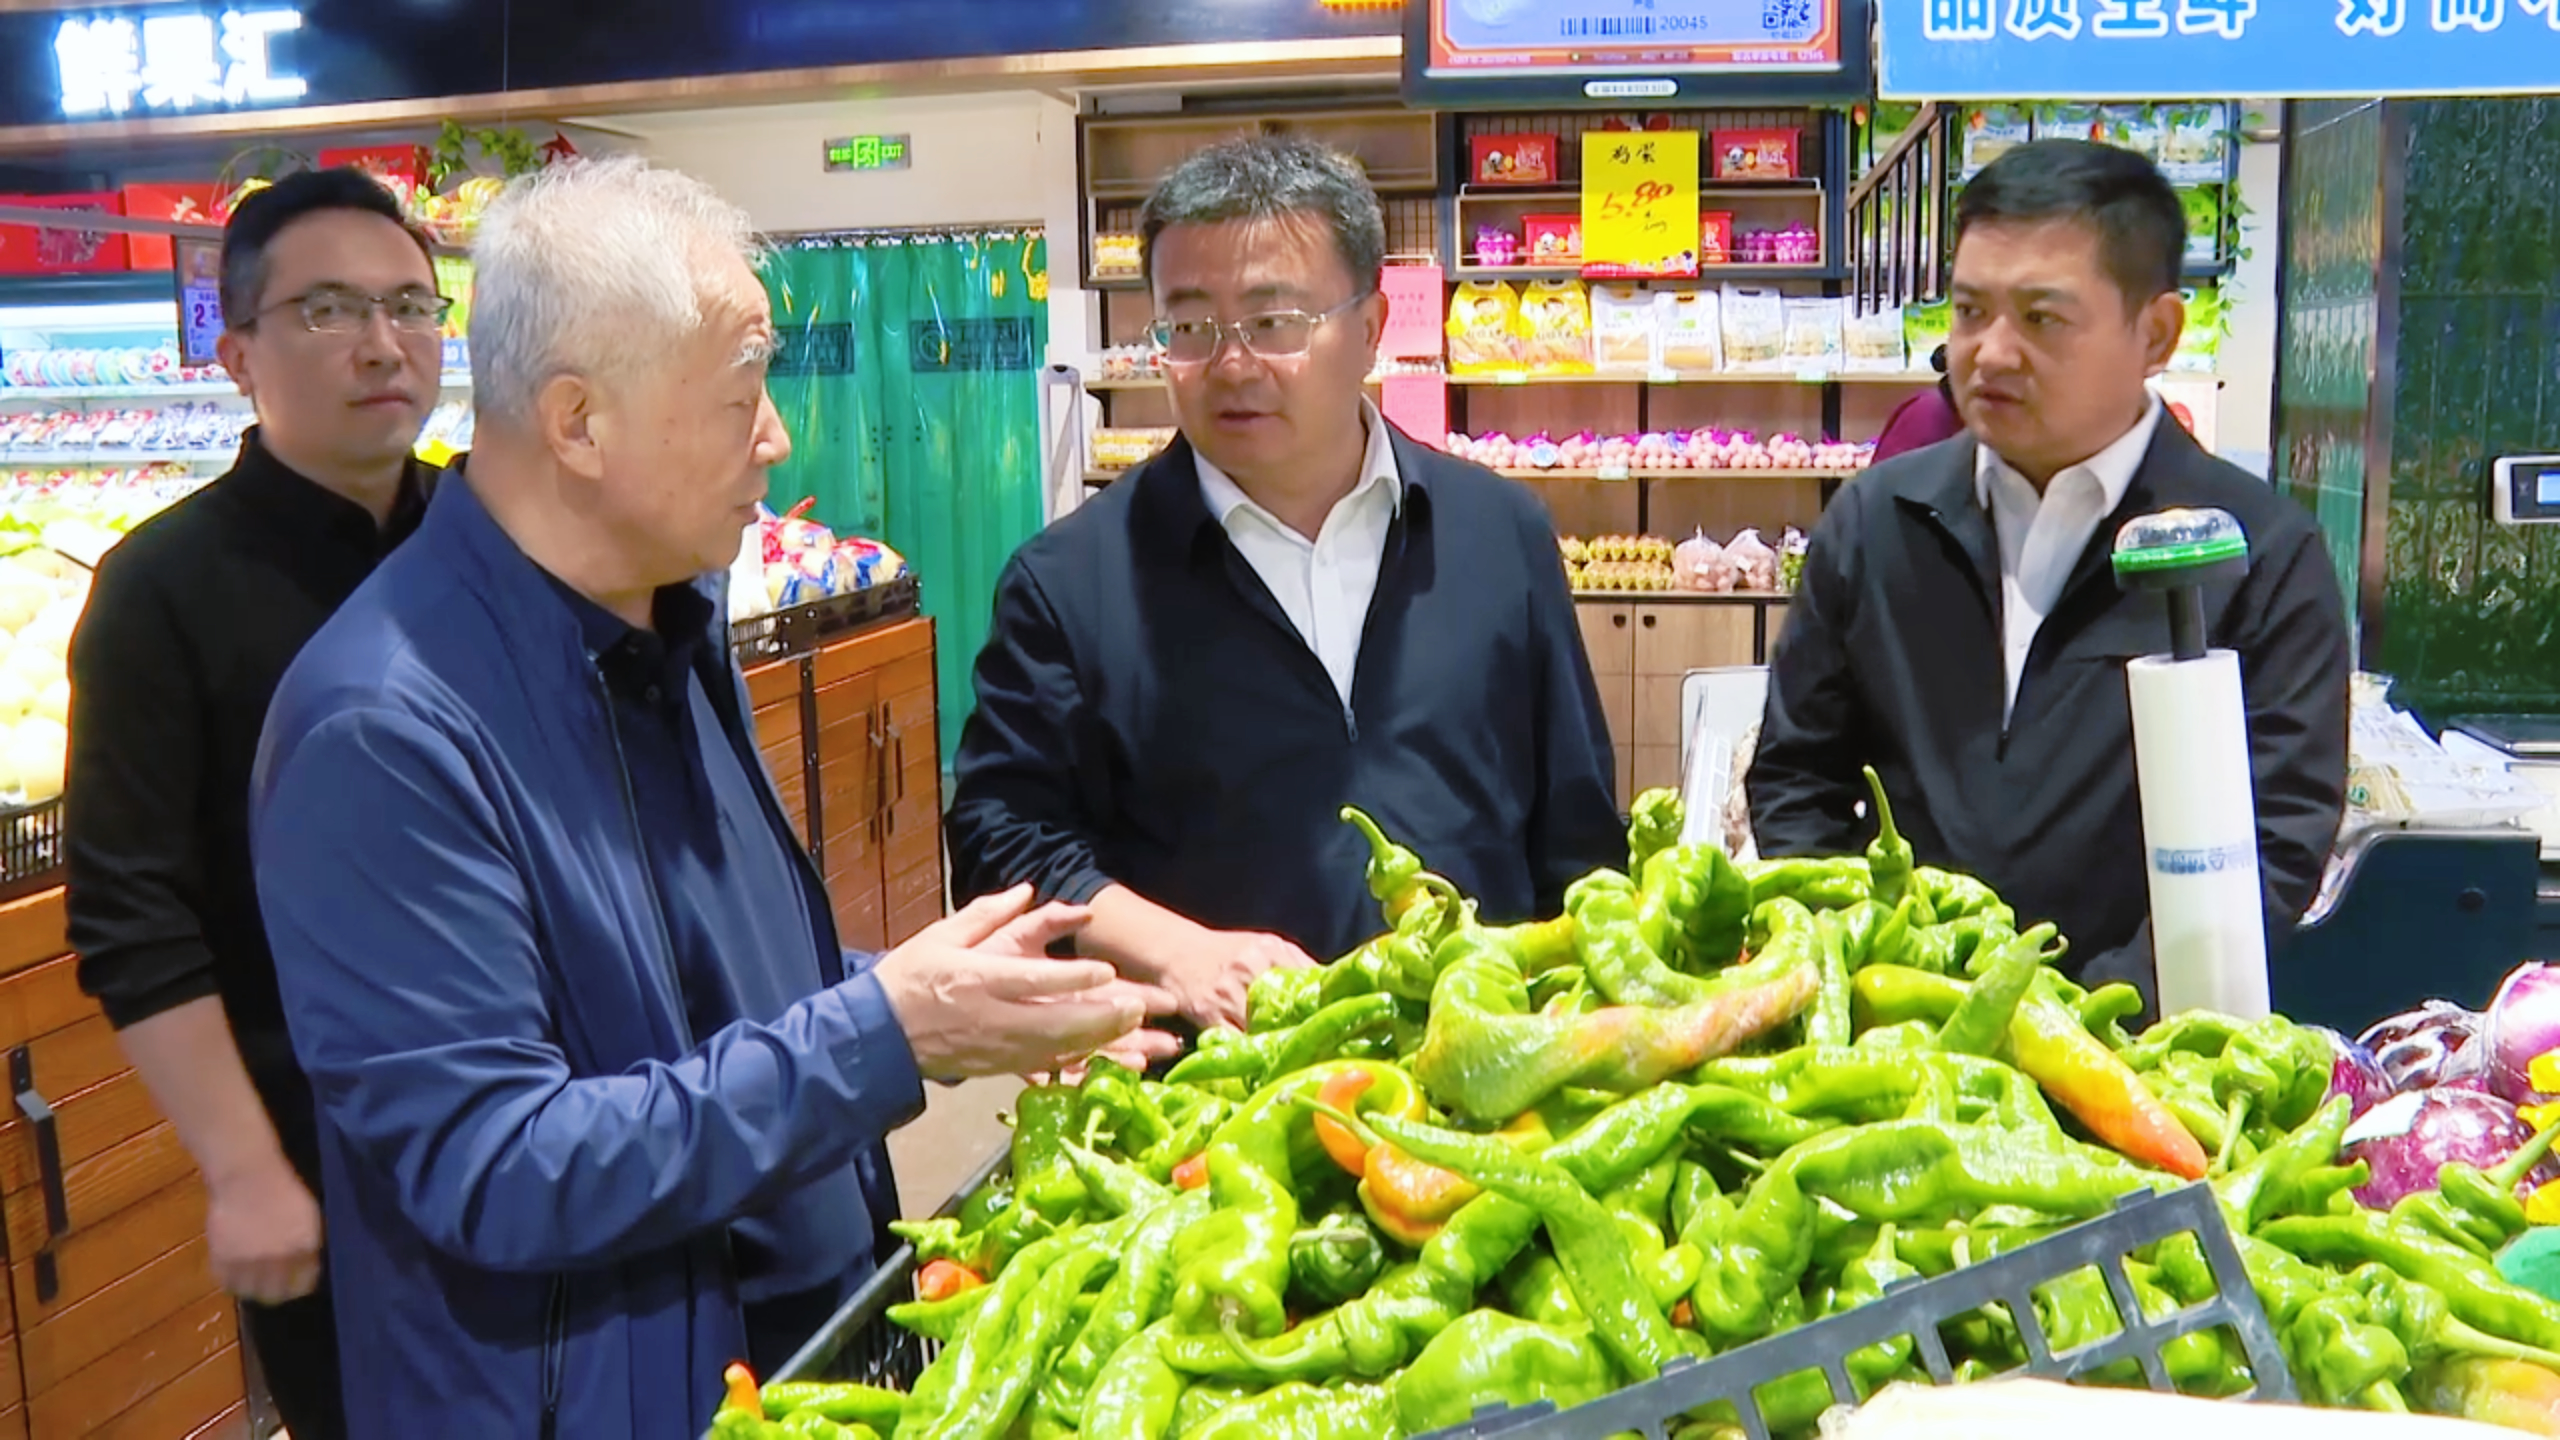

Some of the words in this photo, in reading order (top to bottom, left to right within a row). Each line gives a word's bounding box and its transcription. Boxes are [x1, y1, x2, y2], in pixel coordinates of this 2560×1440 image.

[1660, 16, 1708, 31] 20045
[54, 9, 308, 114] 鲜果汇
[1600, 180, 1675, 220] 5.80
